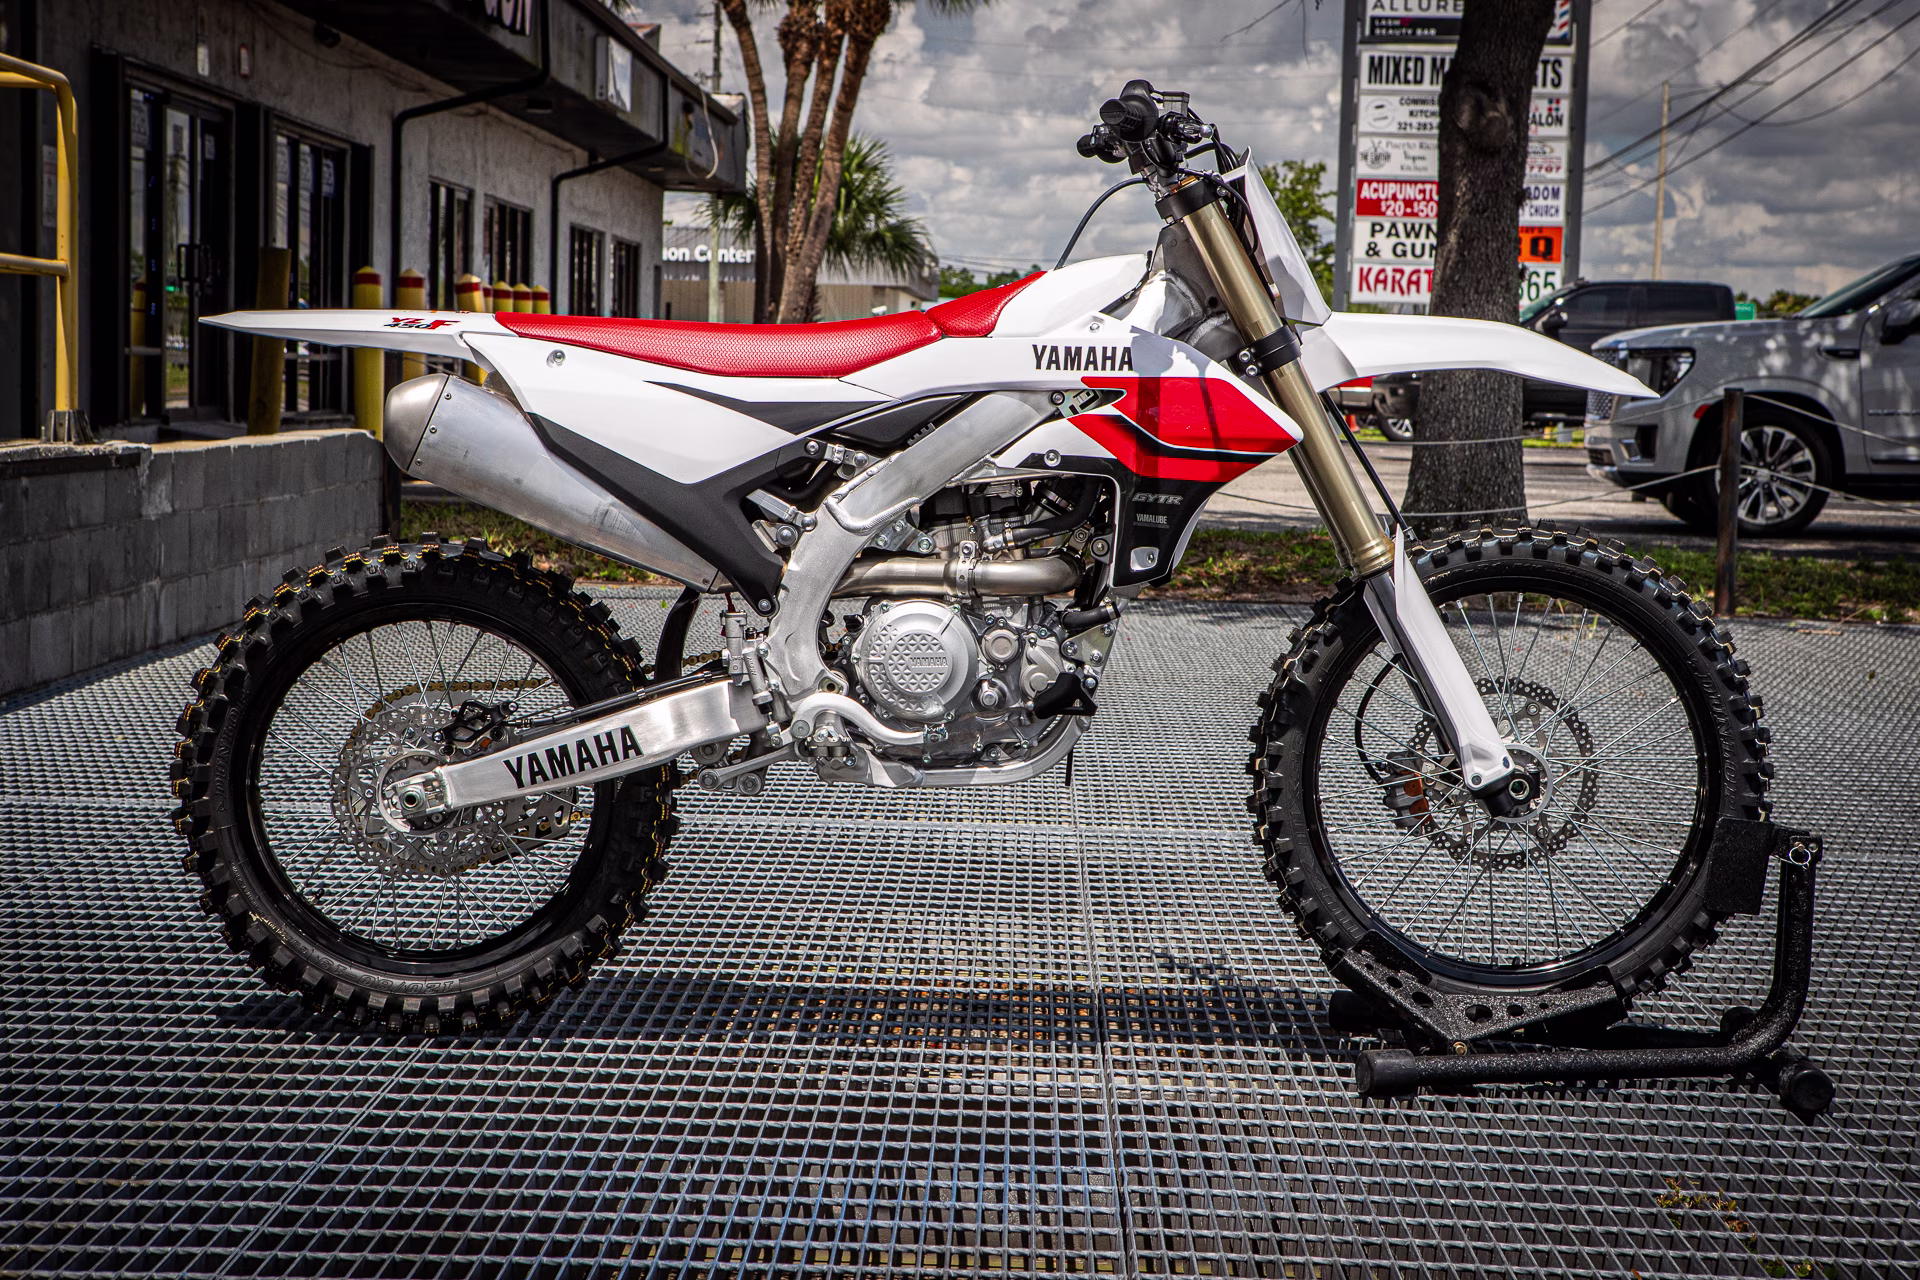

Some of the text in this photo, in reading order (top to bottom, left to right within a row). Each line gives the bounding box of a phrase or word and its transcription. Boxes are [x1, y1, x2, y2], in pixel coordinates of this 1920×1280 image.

[1371, 0, 1464, 12] ALLURE
[1374, 28, 1437, 37] BEAUTY BAR
[1368, 55, 1424, 85] MIXED
[1535, 59, 1562, 88] TS
[1529, 204, 1559, 217] CHURCH
[1370, 222, 1437, 239] PAWN
[1365, 242, 1381, 258] &
[1032, 344, 1134, 372] YAMAHA
[1132, 491, 1184, 506] GYTR
[1136, 512, 1168, 525] YAMALUBE
[909, 656, 949, 669] YAMAHA
[502, 725, 644, 790] YAMAHA
